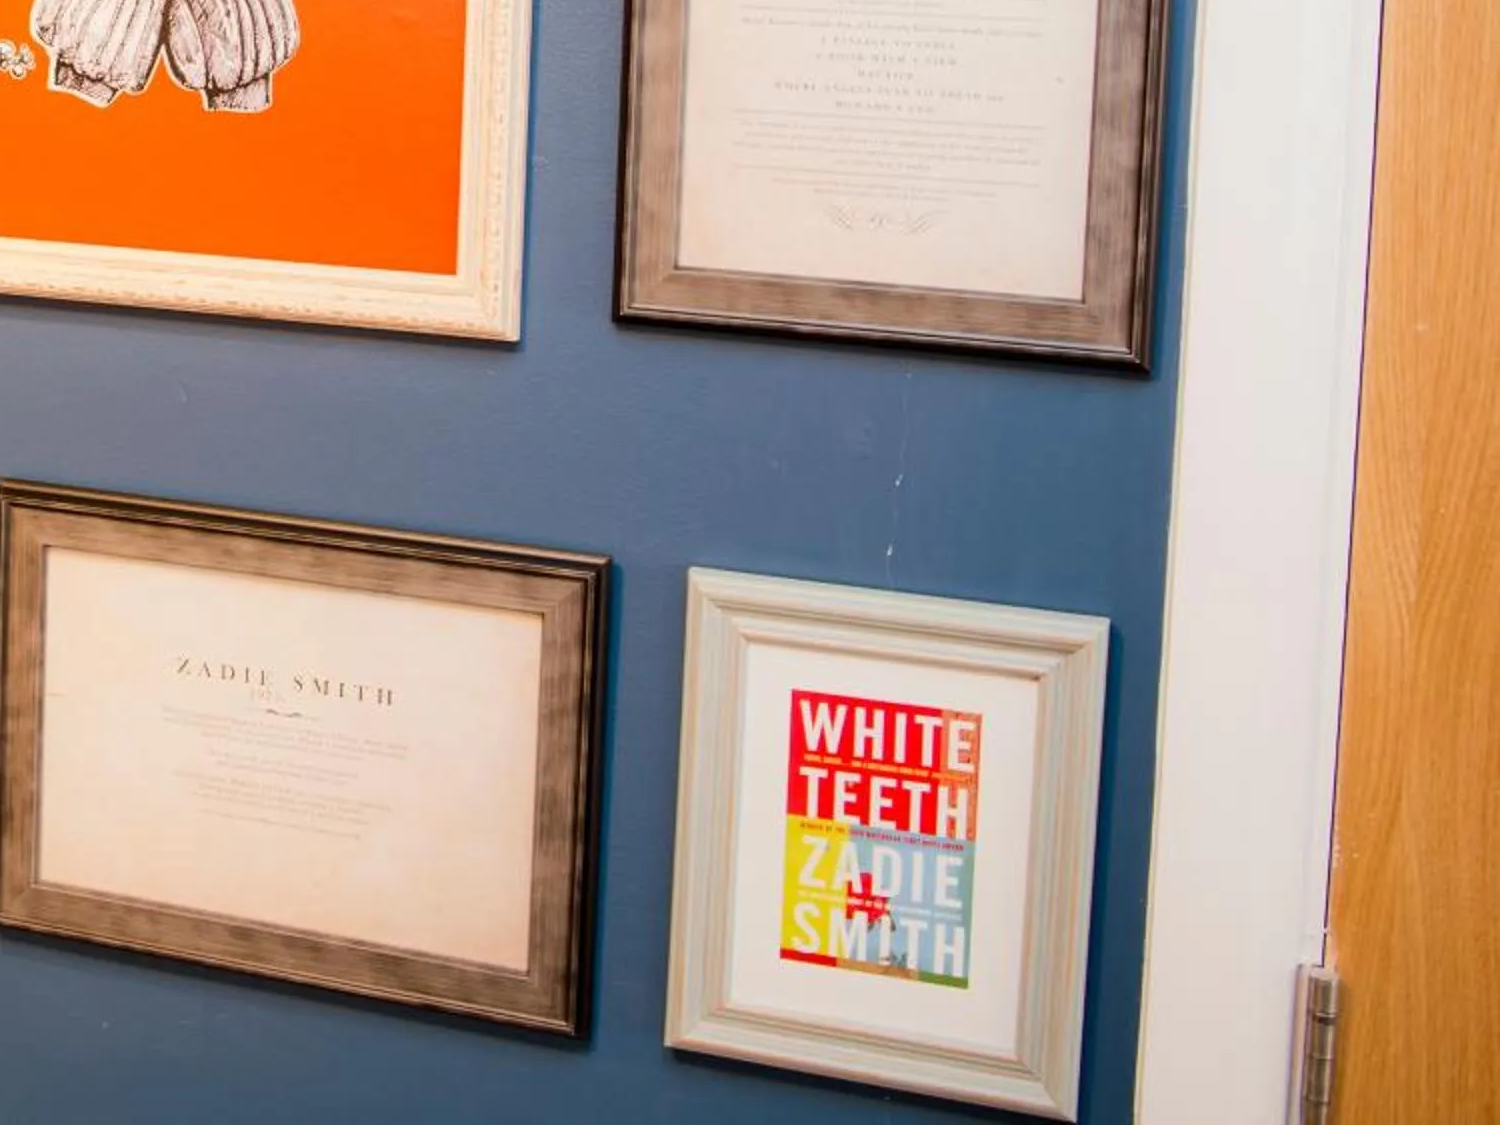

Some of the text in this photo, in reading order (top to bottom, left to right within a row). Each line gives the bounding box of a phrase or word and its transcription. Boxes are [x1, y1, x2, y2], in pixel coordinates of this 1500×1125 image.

[176, 656, 271, 686] ZADIE
[292, 674, 395, 706] SMITH
[800, 699, 975, 774] WHITE
[799, 766, 970, 842] TEETH
[798, 834, 965, 910] ZADIE
[792, 903, 966, 979] SMITH
